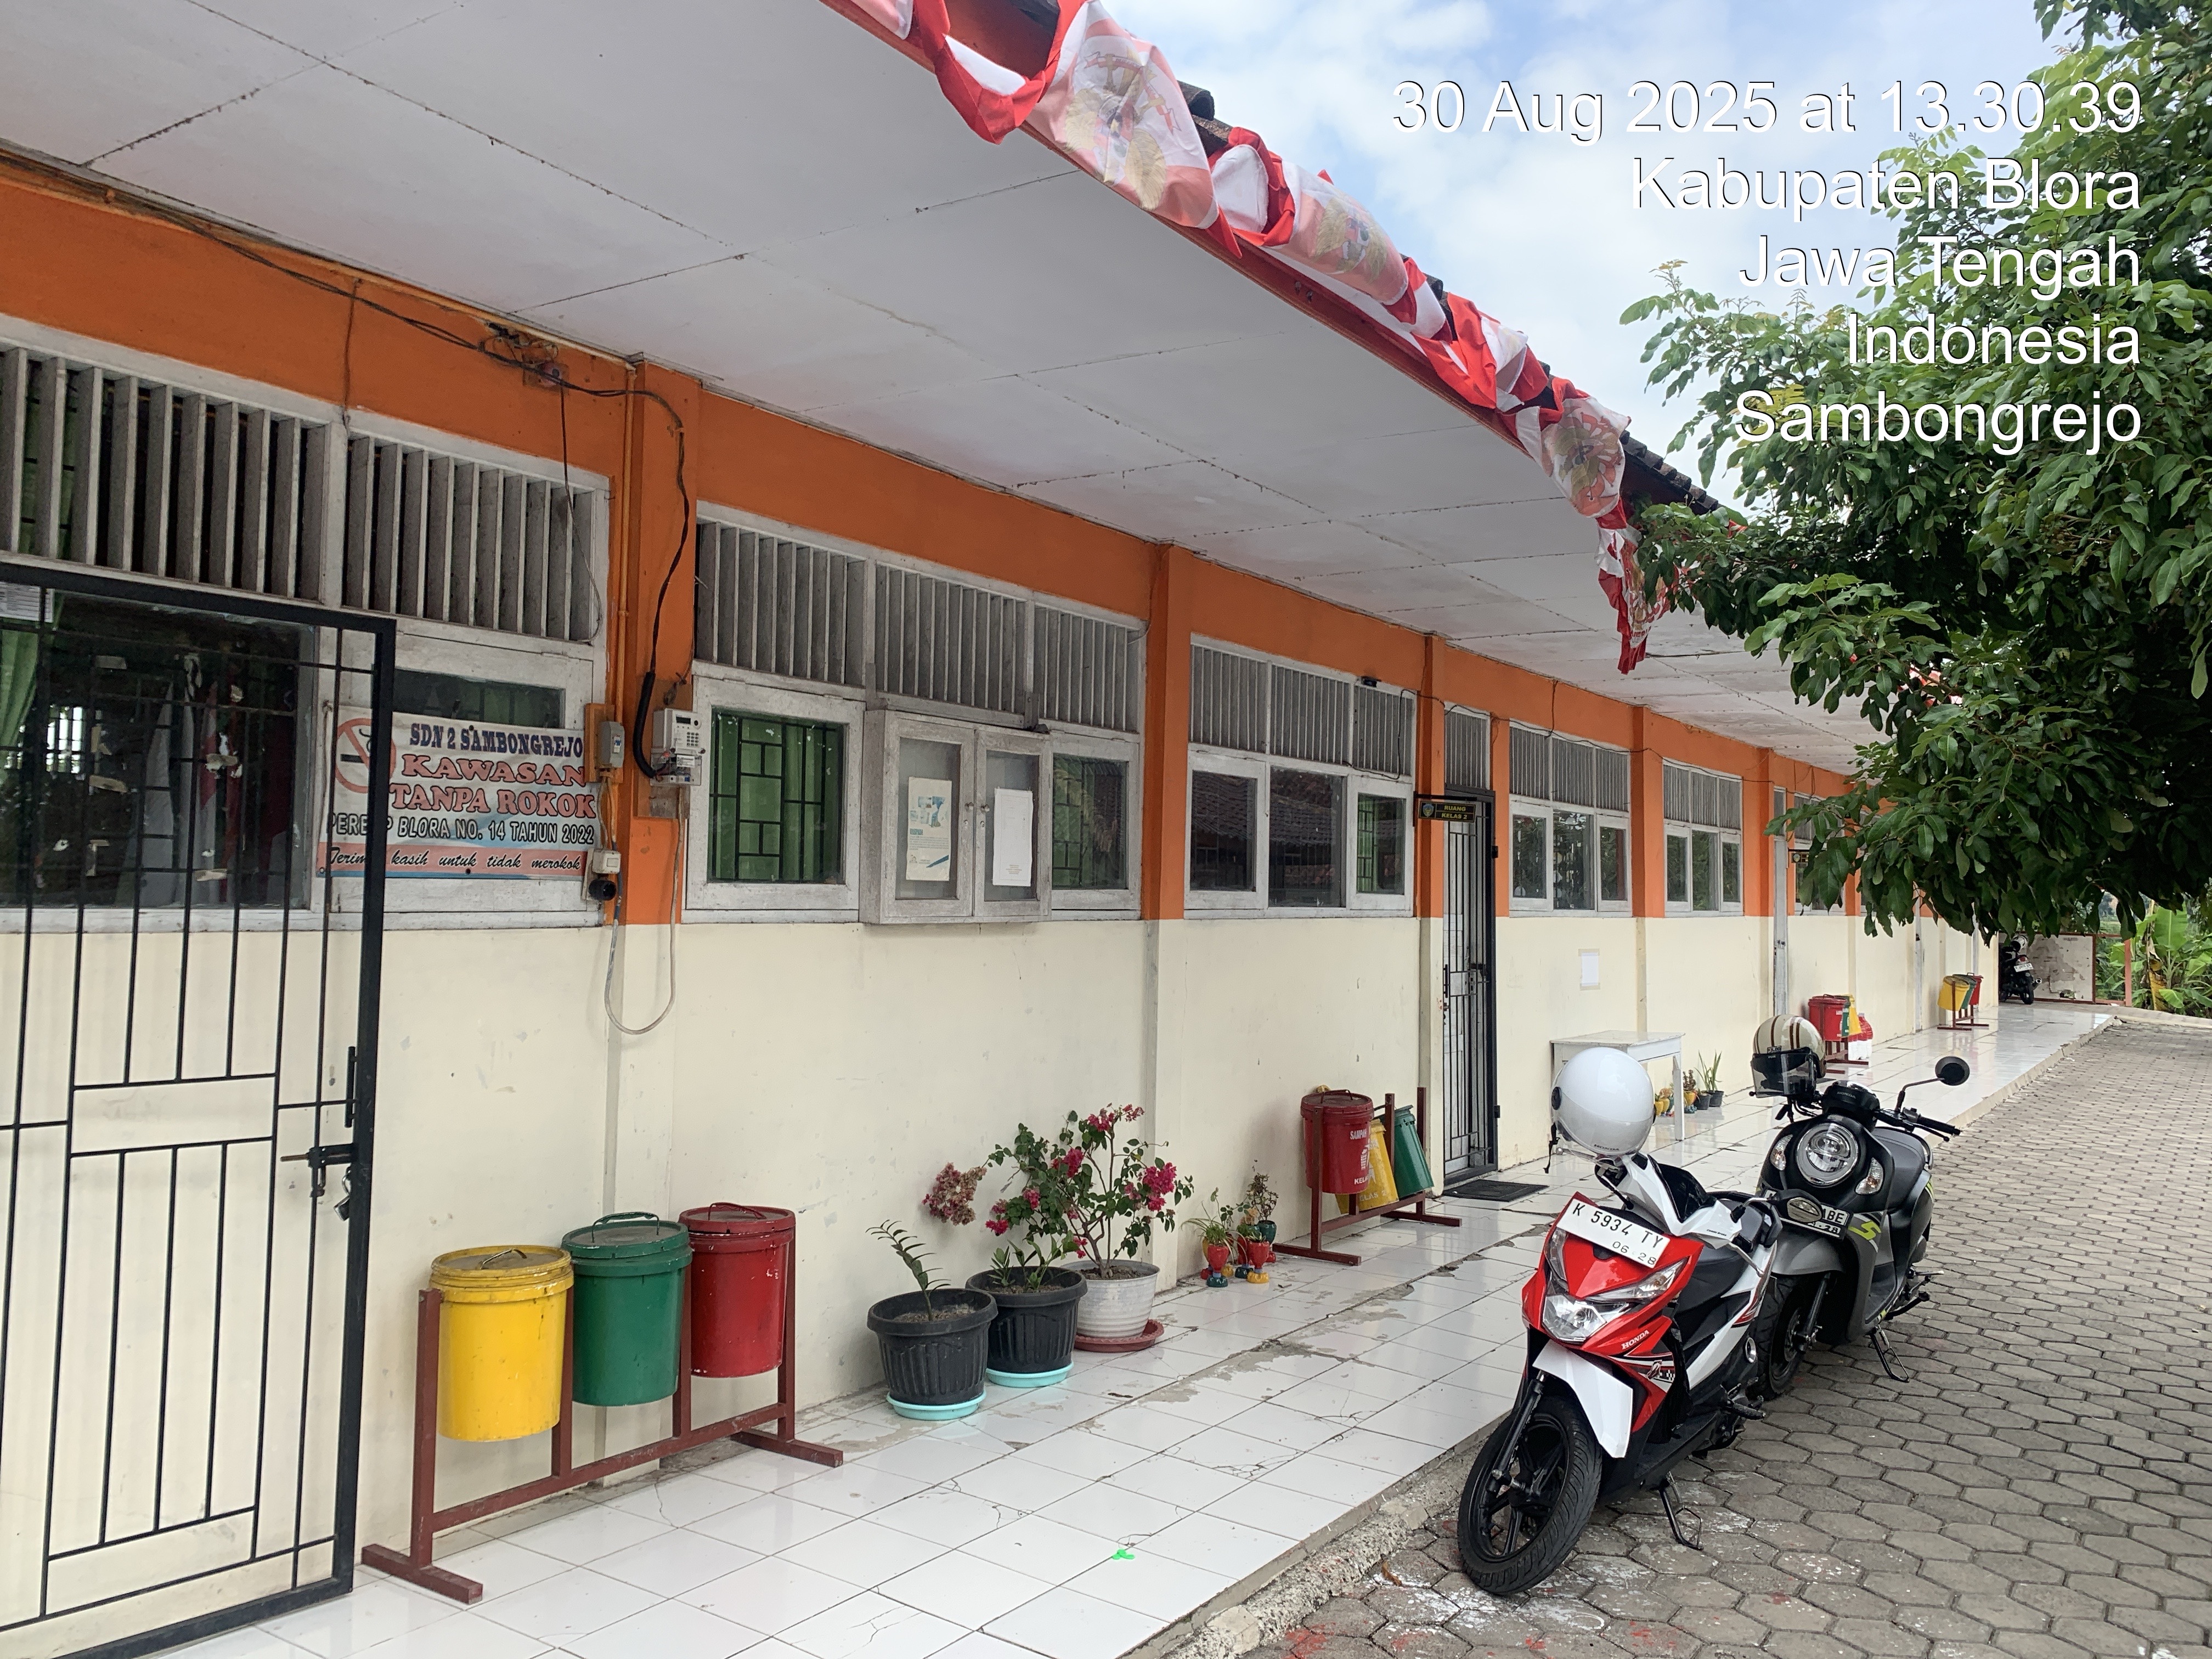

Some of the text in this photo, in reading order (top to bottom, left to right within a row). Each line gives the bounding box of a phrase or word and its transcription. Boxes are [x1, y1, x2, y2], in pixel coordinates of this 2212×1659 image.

[409, 723, 583, 758] SDN 2 SAMBONGREJO
[401, 753, 586, 788] KAWASAN
[388, 782, 596, 819] TANPA ROKOK
[398, 816, 450, 839] BLORA
[455, 819, 483, 840] NO.
[488, 821, 506, 841] 14
[510, 822, 557, 844] TAHUN
[561, 823, 594, 844] 2022
[391, 849, 429, 865] kasih
[438, 851, 477, 867] untuk
[486, 853, 522, 868] tidak
[531, 856, 581, 870] merokok
[1572, 1203, 1663, 1248] K 5934 TY
[1612, 1241, 1657, 1266] 06 28
[1621, 1330, 1650, 1350] HONDA
